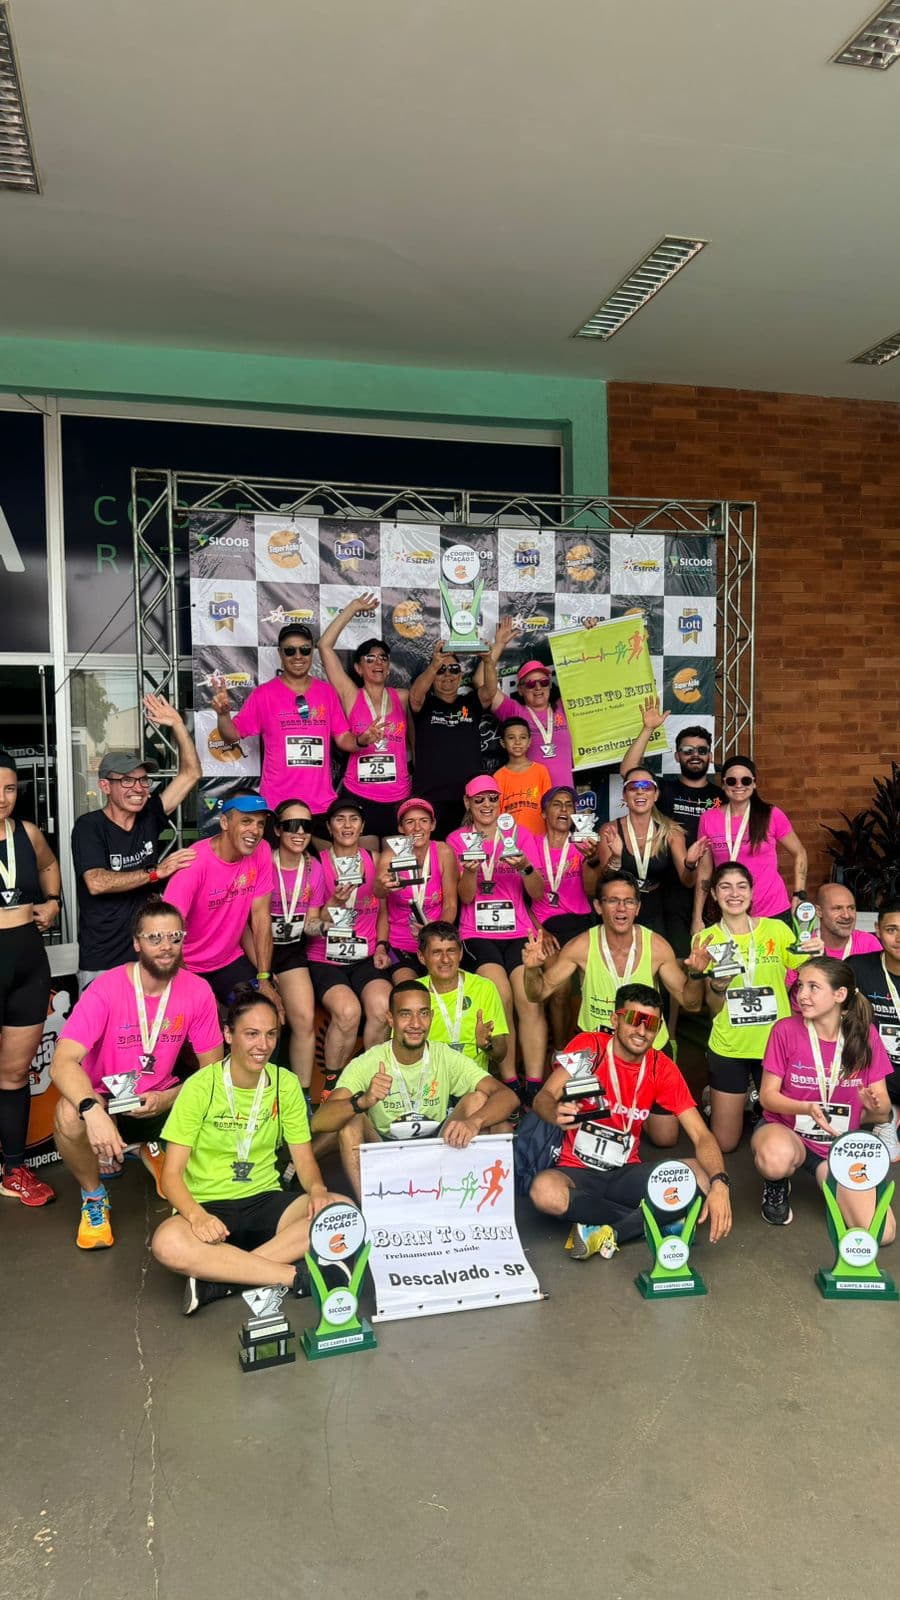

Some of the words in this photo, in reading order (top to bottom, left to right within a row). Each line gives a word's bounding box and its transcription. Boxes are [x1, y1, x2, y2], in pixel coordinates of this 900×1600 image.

[209, 536, 249, 547] SICOOB
[337, 544, 361, 556] Lott
[515, 552, 539, 565] Lott
[679, 557, 713, 566] SICOOB
[632, 564, 661, 572] Estrela
[211, 604, 238, 616] Lott
[679, 619, 701, 630] Lott
[604, 689, 623, 702] TO
[300, 744, 312, 757] 21
[369, 763, 385, 775] 25
[577, 796, 595, 807] ott
[491, 910, 500, 922] 5
[338, 943, 356, 957] 24
[411, 1122, 421, 1137] 2
[594, 1137, 608, 1156] 11
[843, 1142, 882, 1150] COOPER
[846, 1149, 874, 1159] AÇÃO
[658, 1168, 690, 1177] COOPER
[661, 1174, 684, 1184] AÇÃO
[323, 1211, 358, 1224] COOPER
[326, 1220, 351, 1232] AÇÃO
[384, 1251, 443, 1261] Treinamento
[453, 1244, 480, 1254] Saúde
[663, 1252, 684, 1260] SICOOB
[388, 1264, 490, 1287] Descalvado
[503, 1263, 525, 1276] SP
[328, 1305, 352, 1314] SICOOB
